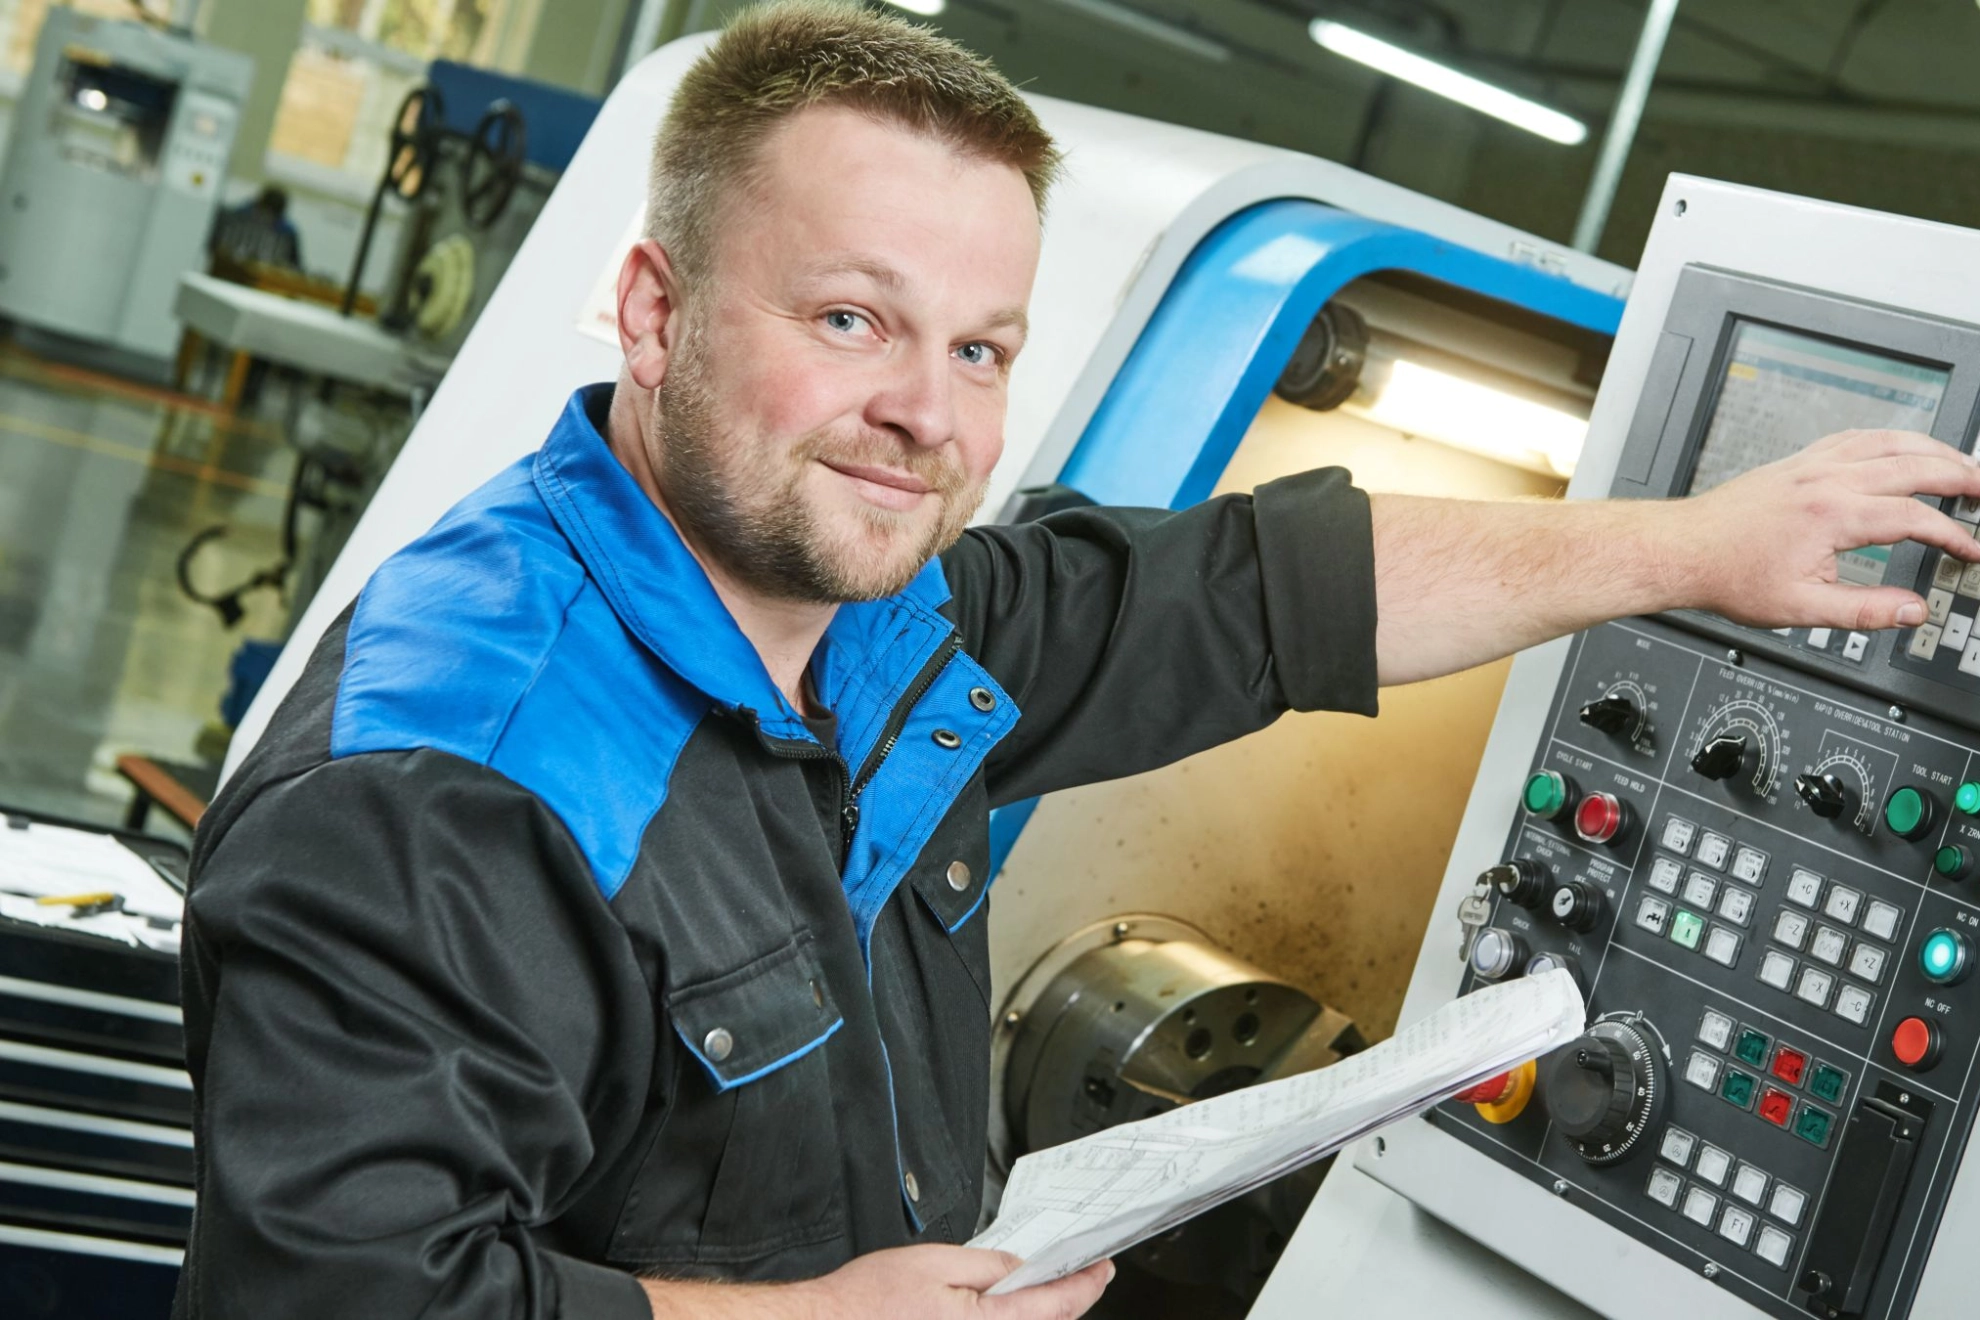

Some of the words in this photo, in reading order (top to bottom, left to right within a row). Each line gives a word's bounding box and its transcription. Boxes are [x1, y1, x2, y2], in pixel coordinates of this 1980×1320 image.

[1719, 668, 1735, 680] FEED
[1736, 674, 1766, 692] OVERRIDE
[1814, 701, 1833, 715] RAPID
[1884, 726, 1910, 743] STATION
[1556, 750, 1574, 764] CYCLE
[1575, 758, 1593, 772] START
[1804, 764, 1813, 774] 100
[1912, 764, 1928, 777] TOOL
[1931, 771, 1953, 785] START
[1614, 773, 1629, 786] FEED
[1630, 781, 1646, 793] HOLD
[1959, 824, 1966, 834] X
[1536, 845, 1553, 858] CHUCK
[1551, 864, 1560, 874] EX
[1589, 858, 1615, 875] PROGRAM
[1587, 867, 1611, 883] PROTECT
[1606, 888, 1615, 898] ON
[1802, 884, 1813, 895] +C
[1839, 899, 1851, 911] +X
[1512, 917, 1531, 931] CHUCK
[1956, 911, 1968, 922] NC
[1968, 916, 1980, 927] ON
[1788, 923, 1800, 935] -Z
[1568, 942, 1581, 956] TAIL
[1864, 957, 1877, 970] +Z
[1811, 982, 1823, 993] -X
[1851, 1001, 1862, 1012] -C
[1924, 997, 1936, 1008] NC
[1937, 1003, 1952, 1015] OFF
[1637, 1086, 1645, 1096] 40
[1731, 1218, 1745, 1234] F1
